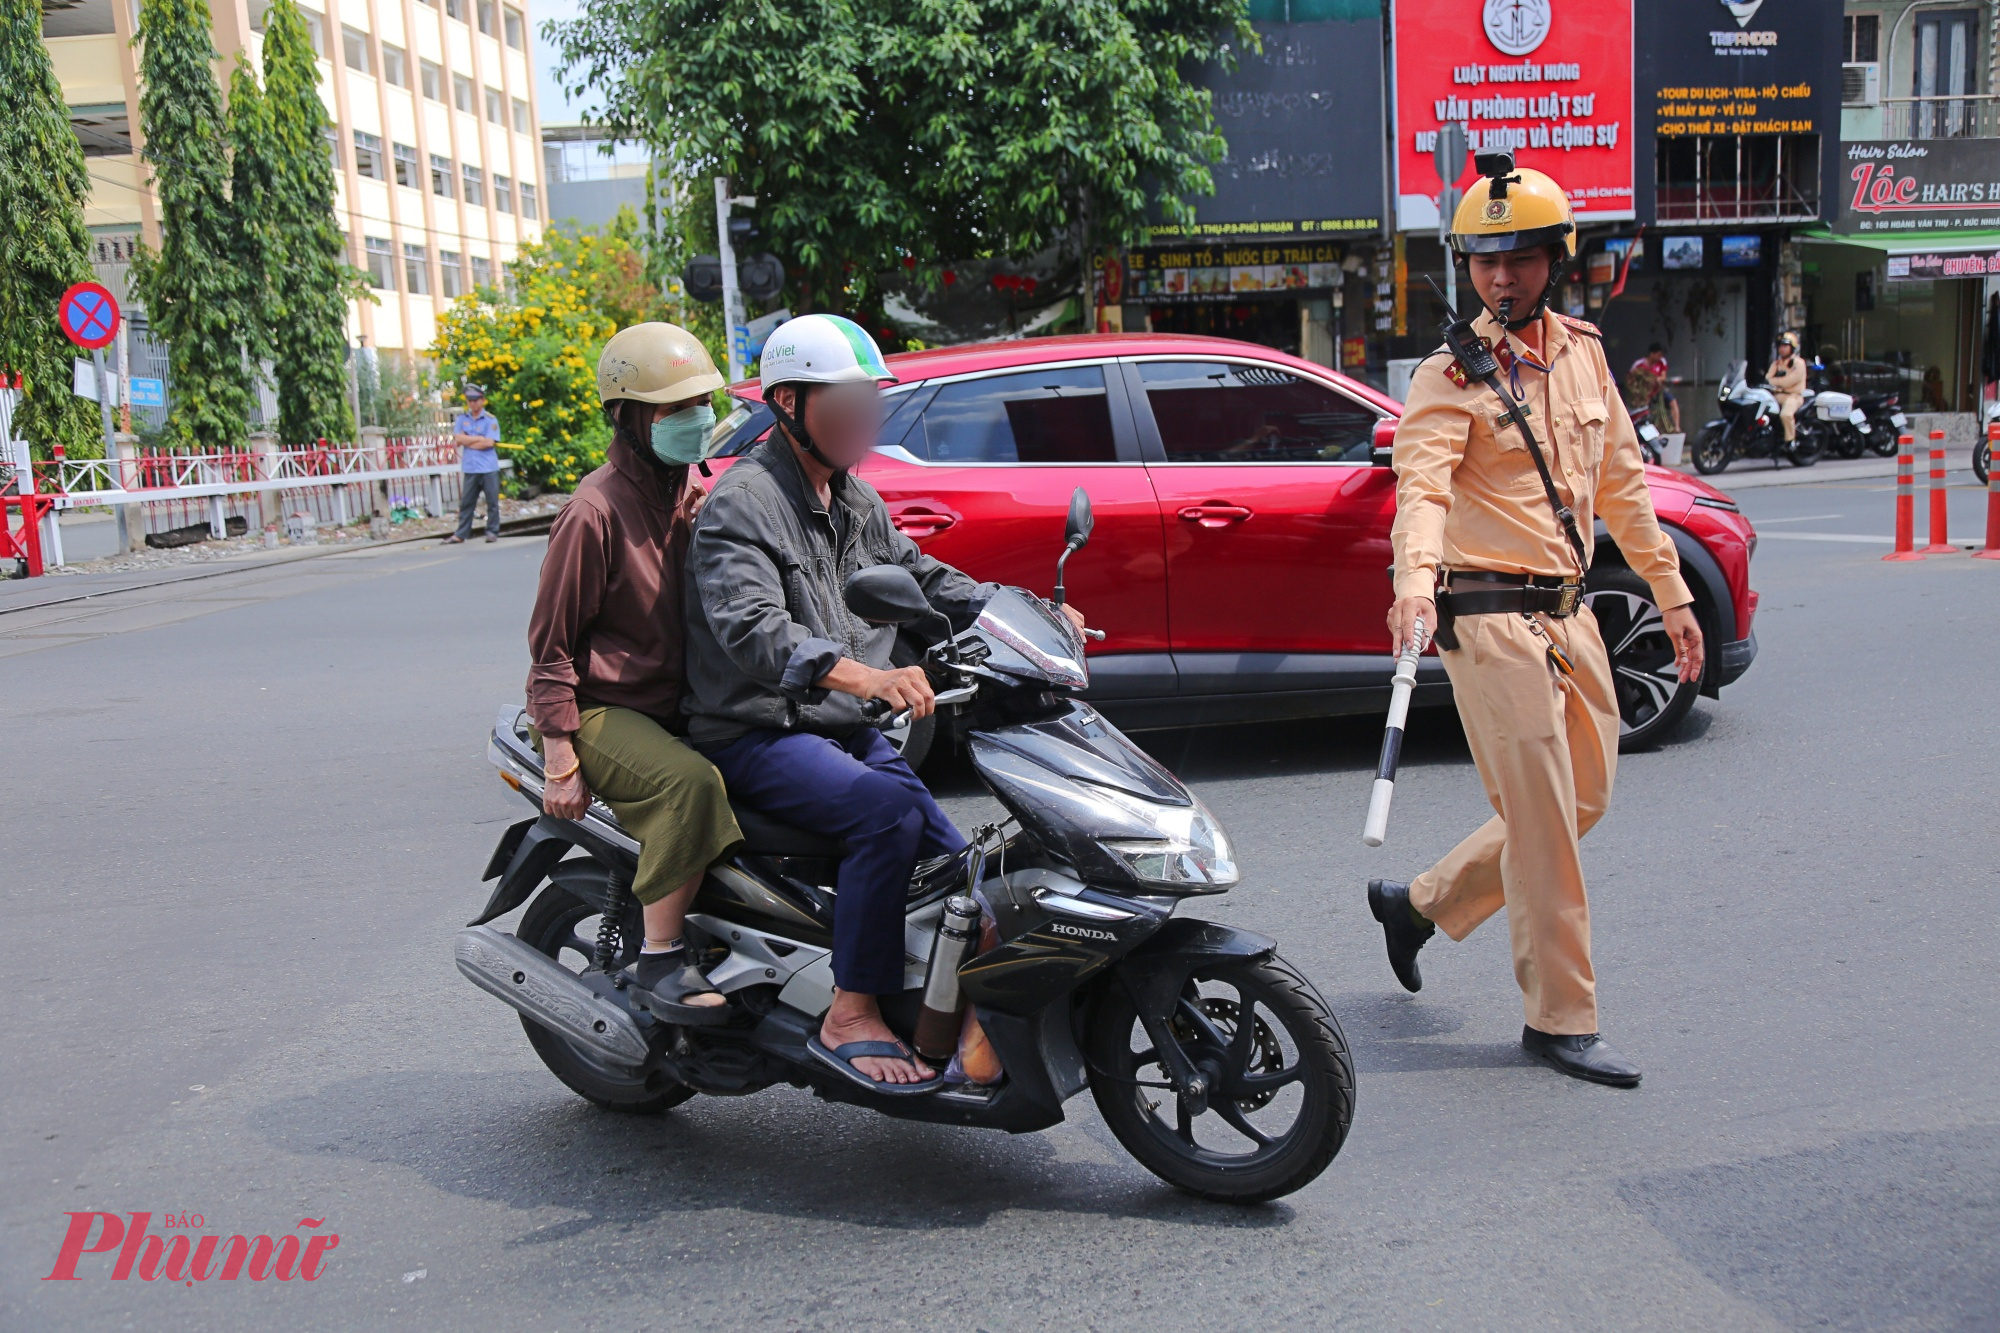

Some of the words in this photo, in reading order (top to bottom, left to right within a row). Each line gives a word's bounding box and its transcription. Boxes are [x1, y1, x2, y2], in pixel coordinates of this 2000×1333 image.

[1709, 31, 1778, 46] TRIPFINDER
[1454, 62, 1486, 86] LUẬT
[1488, 60, 1541, 82] NGUYỄN
[1544, 63, 1580, 80] HƯNG
[1662, 88, 1688, 99] TOUR
[1690, 88, 1704, 99] DU
[1706, 88, 1728, 100] LỊCH
[1734, 87, 1756, 98] VISA
[1762, 84, 1778, 100] HỘ
[1781, 82, 1810, 98] CHIẾU
[1434, 94, 1468, 120] VĂN
[1472, 94, 1526, 120] PHÒNG
[1529, 92, 1570, 120] LUẬT
[1572, 92, 1596, 116] SƯ
[1663, 102, 1675, 116] VÉ
[1676, 102, 1697, 116] MÁY
[1698, 105, 1717, 116] BAY
[1723, 102, 1735, 115] VÉ
[1737, 101, 1756, 115] TÀU
[1688, 120, 1710, 134] THUÊ
[1713, 122, 1725, 134] XE
[1732, 120, 1751, 135] ĐẶT
[1753, 118, 1788, 132] KHÁCH
[1791, 120, 1812, 134] SẠN
[1529, 122, 1550, 148] VÀ
[1552, 122, 1594, 151] CỘNG
[1596, 122, 1619, 150] SỰ
[1848, 144, 1885, 159] Hair
[1887, 142, 1928, 159] Salon
[1922, 183, 1984, 202] HAIR'S
[1260, 221, 1293, 233] NHUẬN
[1891, 218, 1915, 228] HOÀNG
[1918, 218, 1933, 228] VĂN
[1934, 219, 1949, 229] THỤ
[1160, 253, 1191, 268] SINH
[1194, 246, 1213, 266] TỐ
[1224, 250, 1259, 266] NƯỚC
[1263, 248, 1279, 264] ÉP
[1283, 246, 1313, 263] TRÁI
[1944, 254, 1986, 275] CHUYÊN:
[1051, 923, 1118, 941] HONDA
